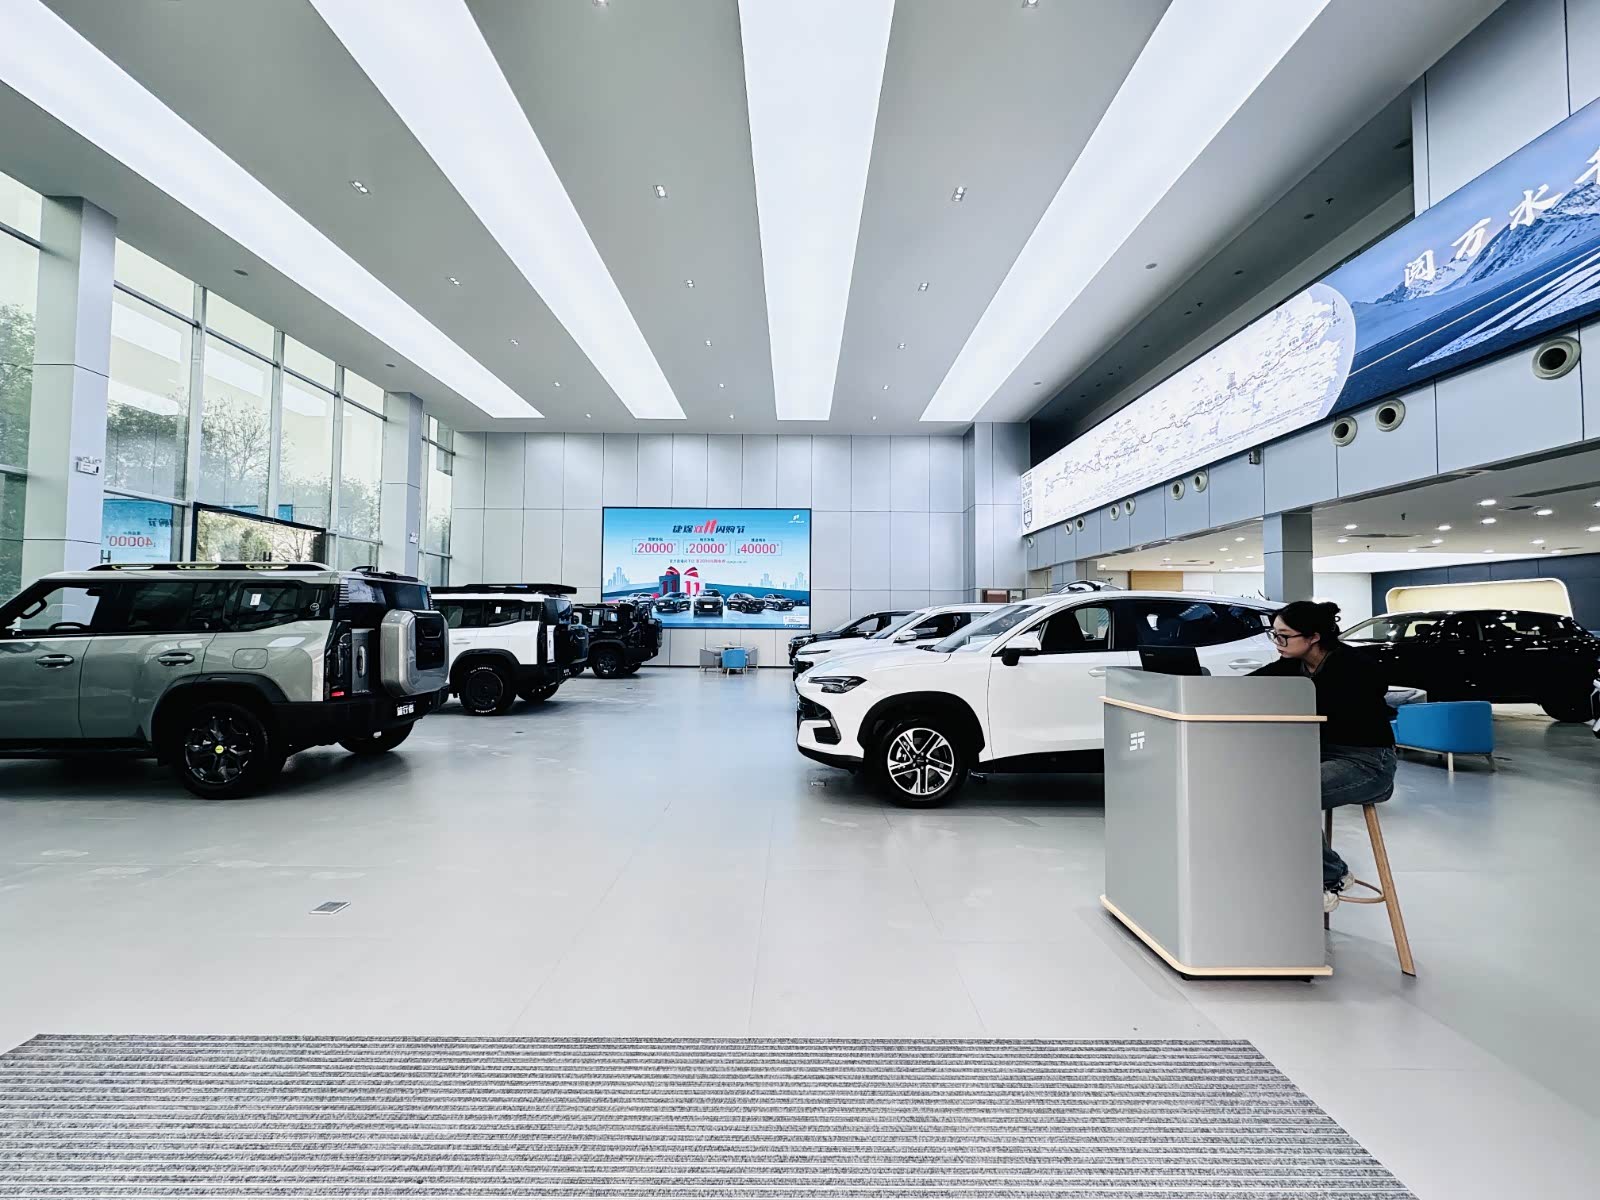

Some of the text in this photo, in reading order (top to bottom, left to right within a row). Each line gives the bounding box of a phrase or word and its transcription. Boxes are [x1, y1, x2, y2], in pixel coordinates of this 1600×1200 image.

[637, 543, 674, 553] 20000
[689, 543, 725, 553] 20000
[741, 543, 776, 554] 40000
